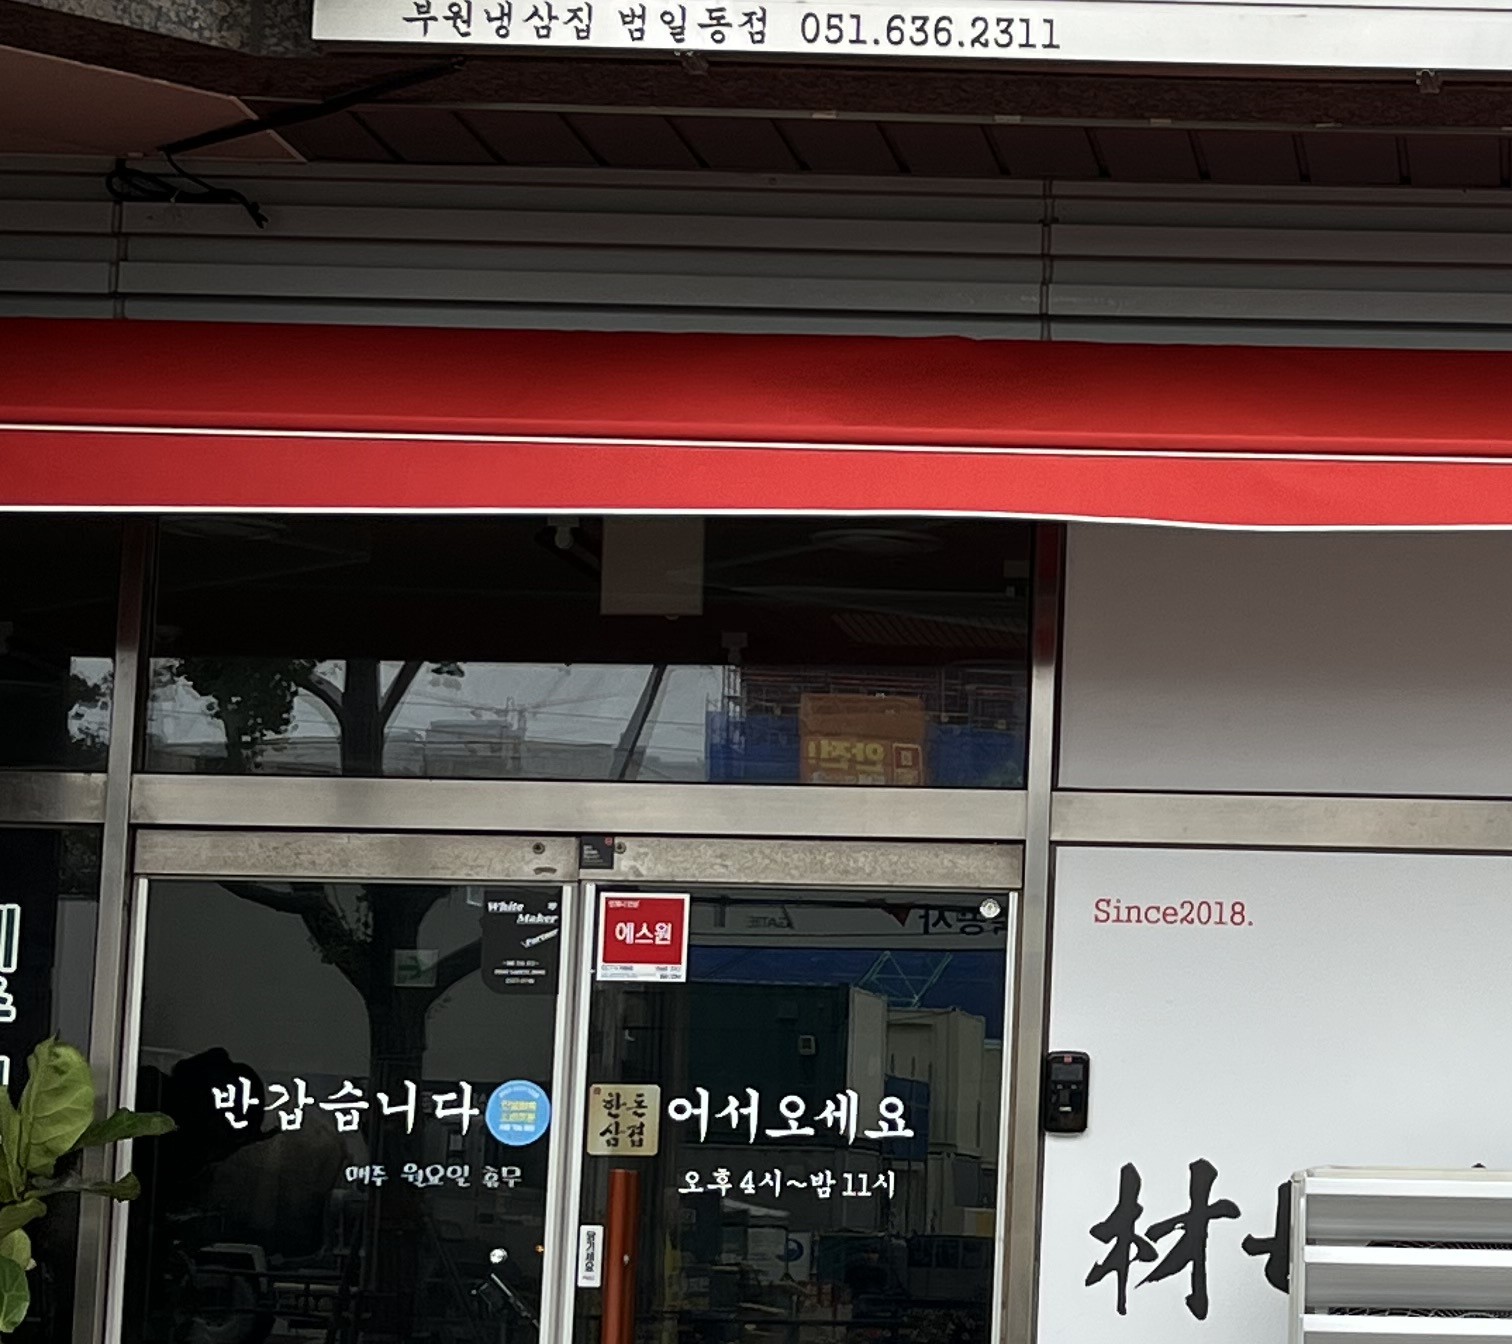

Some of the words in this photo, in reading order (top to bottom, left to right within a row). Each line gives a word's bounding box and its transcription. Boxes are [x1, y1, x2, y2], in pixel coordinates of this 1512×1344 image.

[618, 4, 769, 46] 범일동점
[799, 13, 1061, 51] 051.636.2311
[1093, 898, 1254, 926] Since2018.
[614, 921, 672, 945] 에스원
[211, 1076, 480, 1136] 반갑습니다
[668, 1086, 915, 1144] 어서오세요
[345, 1165, 389, 1187] 매주
[400, 1163, 471, 1188] 월요일
[482, 1165, 523, 1188] 휴무
[678, 1169, 732, 1196] 오후
